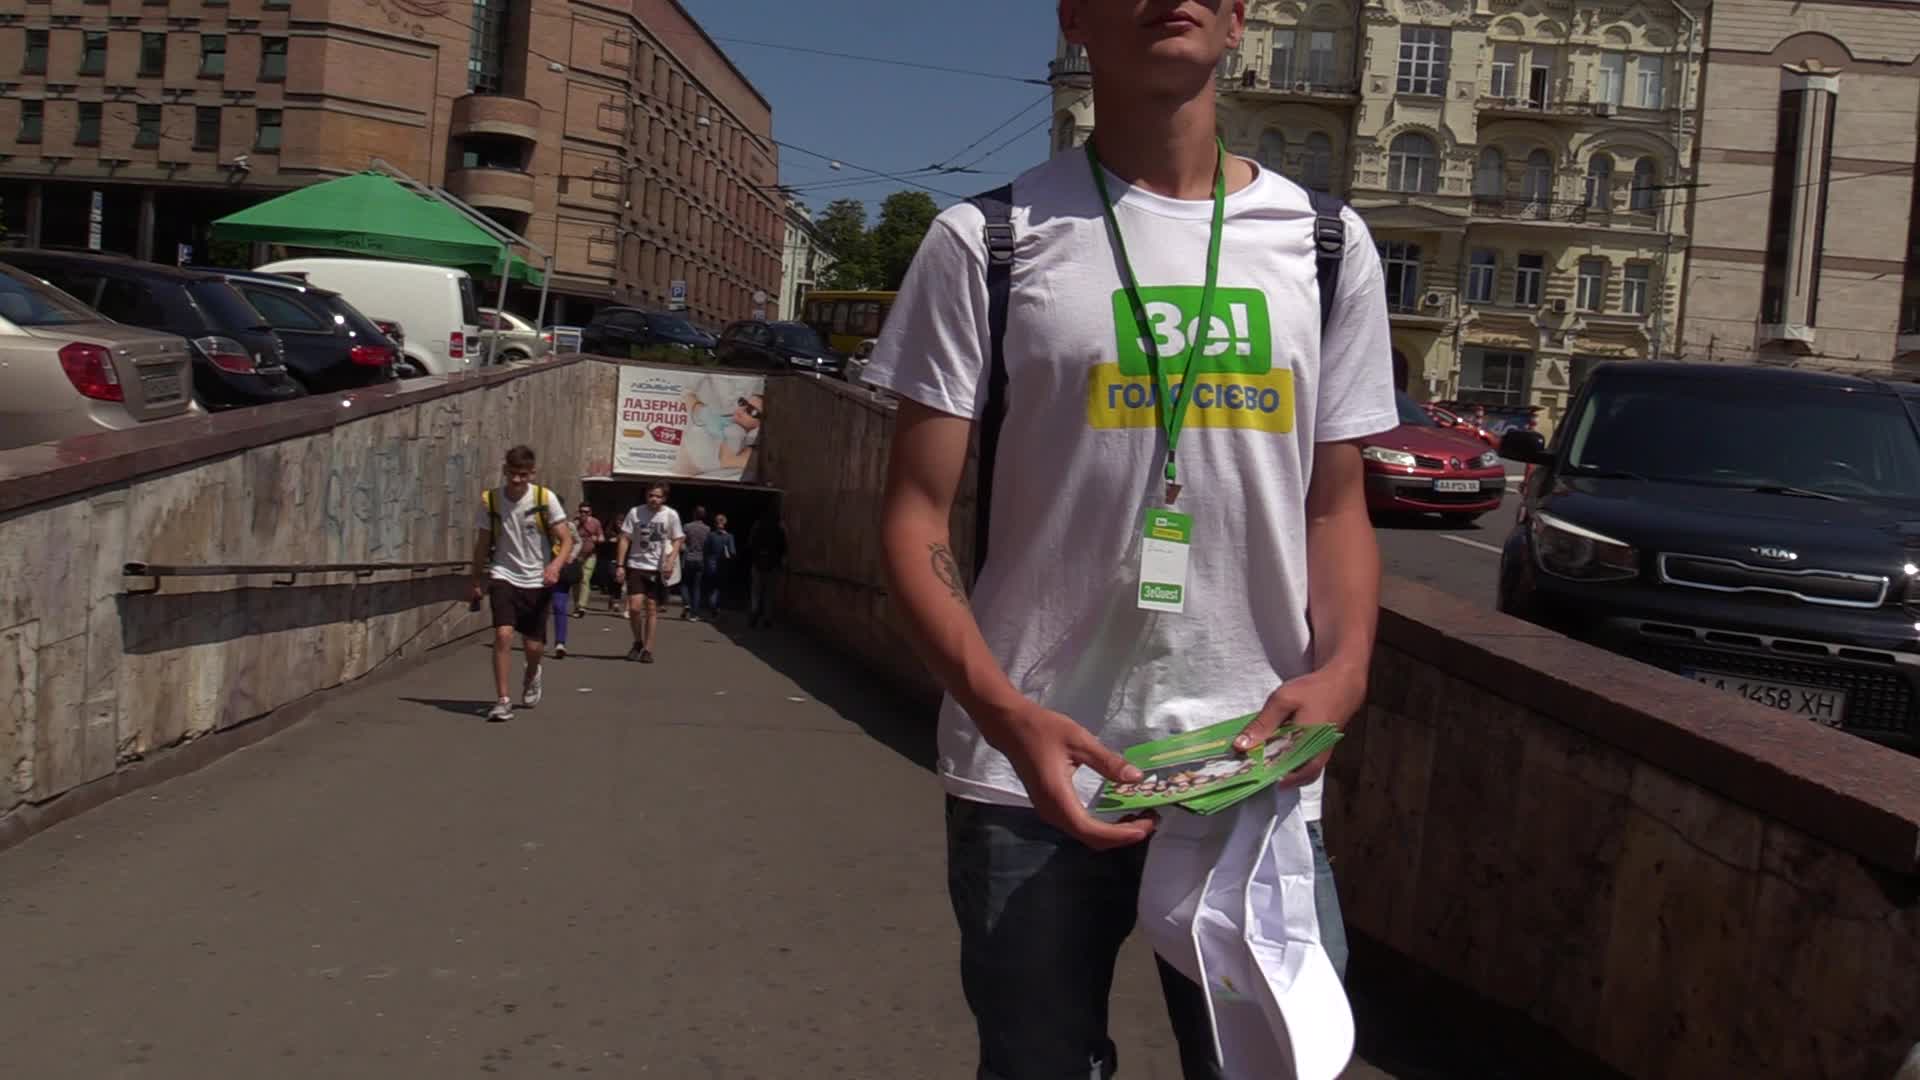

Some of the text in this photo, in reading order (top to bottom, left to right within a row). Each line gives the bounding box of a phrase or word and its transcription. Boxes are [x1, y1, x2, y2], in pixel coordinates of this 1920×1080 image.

[624, 397, 687, 412] ЛАЗЕРНА
[623, 410, 688, 426] ЕПІЛЯЦІЯ
[1760, 547, 1789, 559] KIA
[1738, 683, 1793, 711] 1458
[1798, 689, 1835, 717] XH
